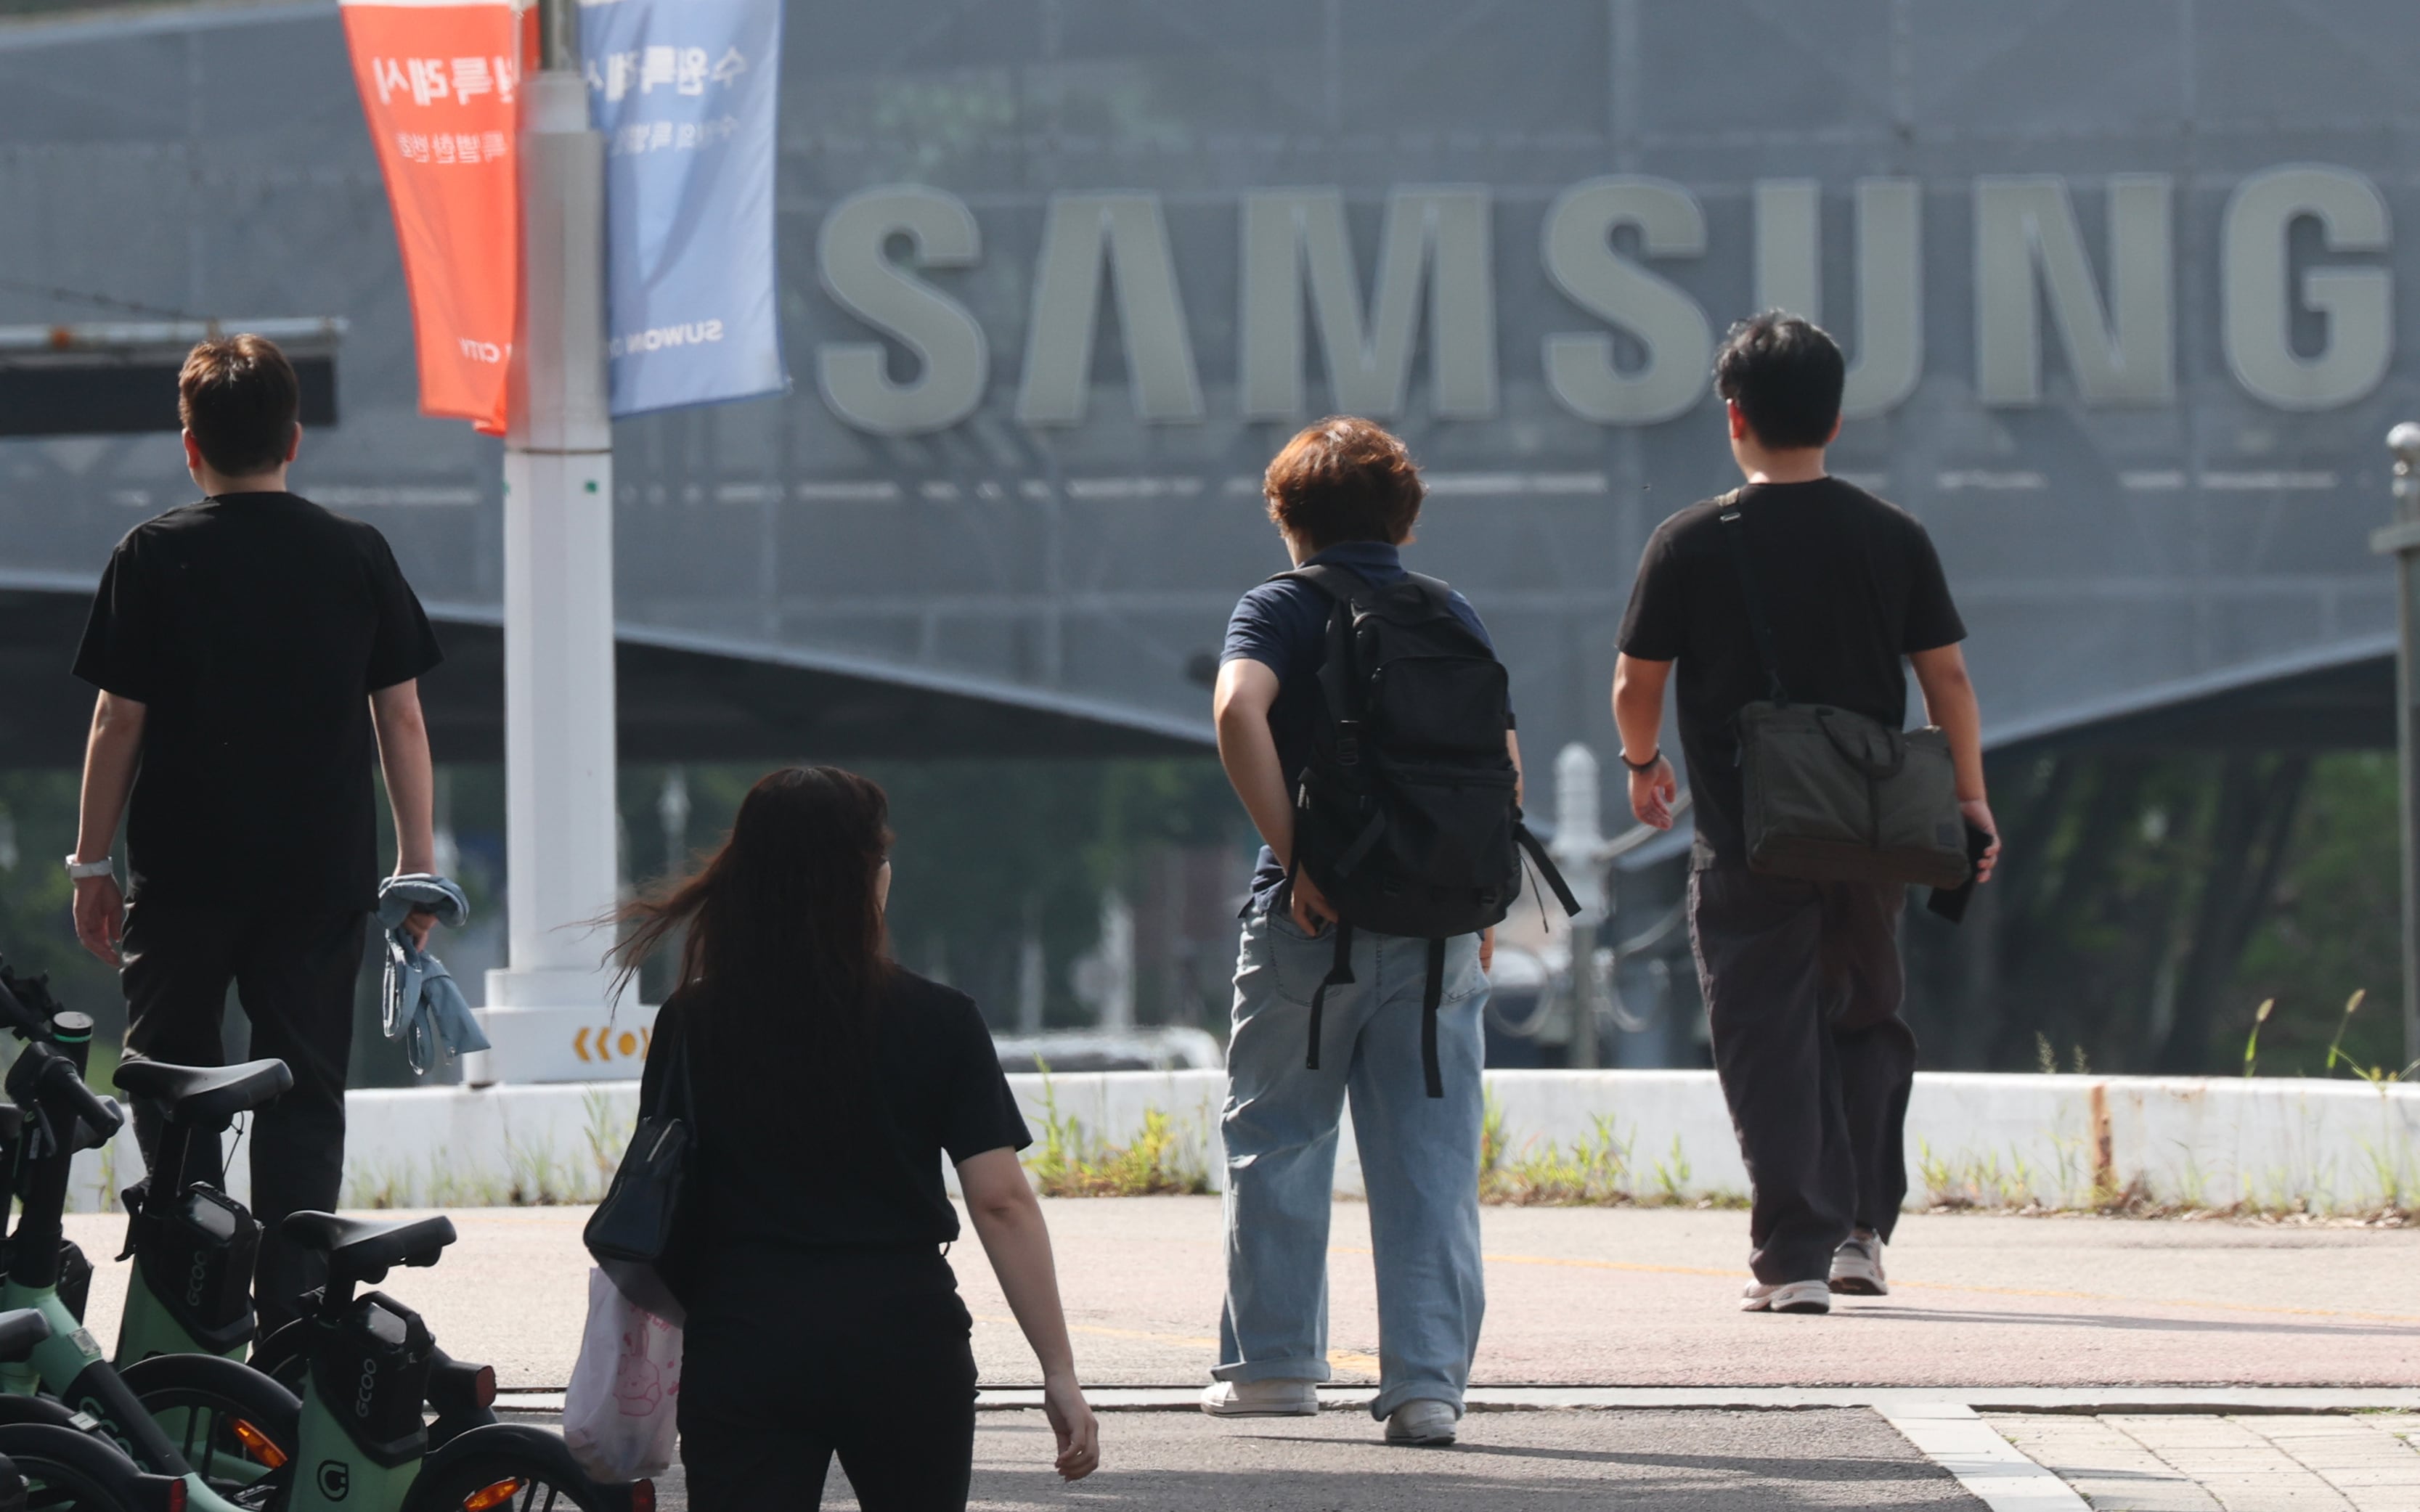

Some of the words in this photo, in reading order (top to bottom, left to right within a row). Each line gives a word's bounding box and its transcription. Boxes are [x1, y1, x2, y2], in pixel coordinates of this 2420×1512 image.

[816, 163, 2394, 433] SAMSUNG
[186, 1250, 207, 1307] GCOO
[355, 1357, 377, 1417] GCOO
